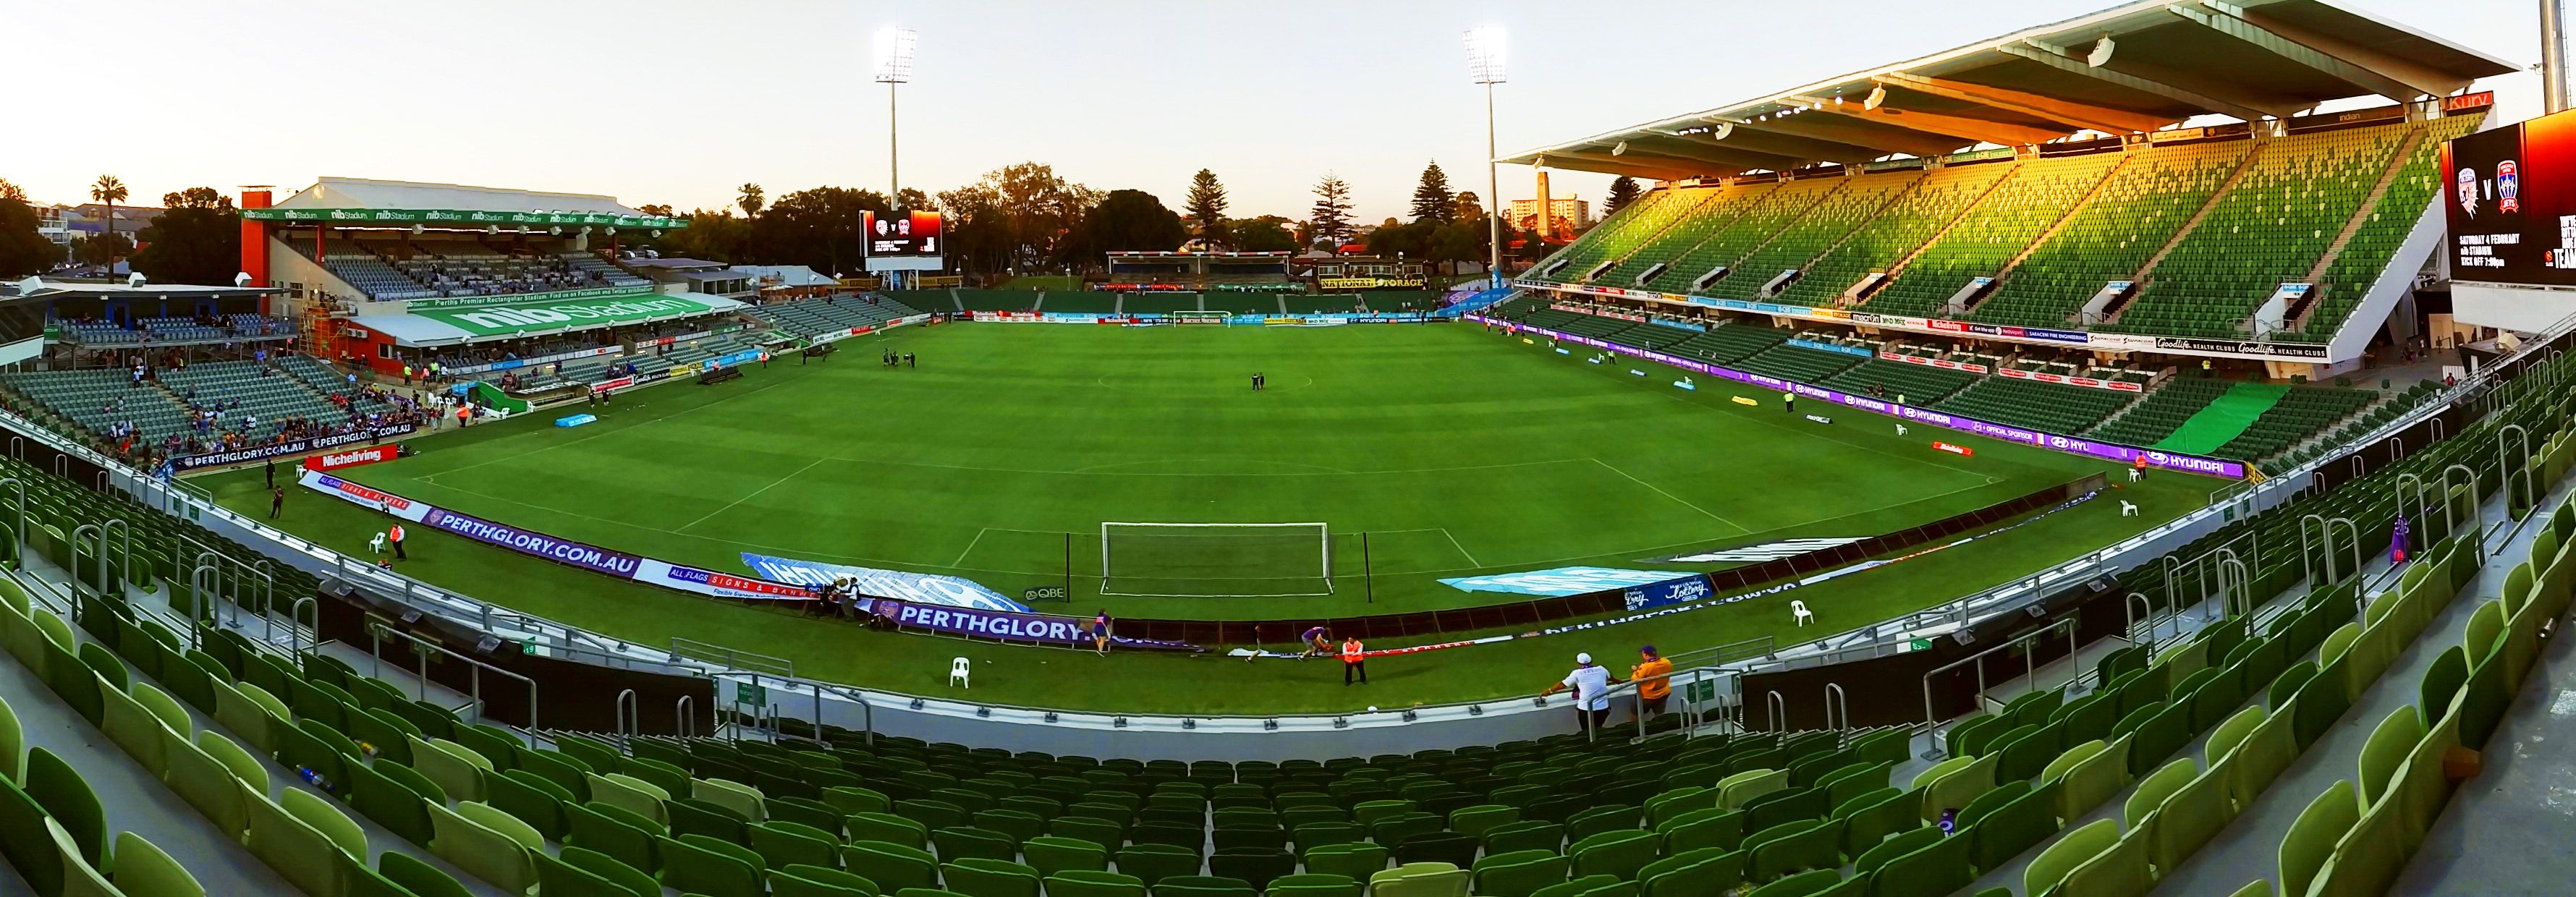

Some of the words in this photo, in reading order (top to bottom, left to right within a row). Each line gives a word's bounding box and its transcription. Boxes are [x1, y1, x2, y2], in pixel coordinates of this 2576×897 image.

[2483, 179, 2491, 200] V
[2460, 235, 2485, 245] SATURDAY
[2486, 236, 2489, 245] 4
[2491, 234, 2520, 245] FEBRUARY
[2470, 246, 2492, 255] STADIUM
[2474, 257, 2483, 266] OFF
[1805, 387, 1830, 399] HYUNDAI
[1855, 398, 1884, 411] HYUNDAI
[1917, 411, 1951, 425] HYUNDAI
[1986, 425, 2007, 436] OFFICIAL
[323, 449, 381, 467] Nicheliving
[2171, 456, 2224, 473] HYUNDAI
[440, 514, 635, 573] PERTHGLORY.COM.AU
[671, 569, 683, 578] ALL
[686, 571, 708, 582] FLAGS
[711, 575, 748, 589] SIGNS
[1038, 588, 1064, 598] QBE
